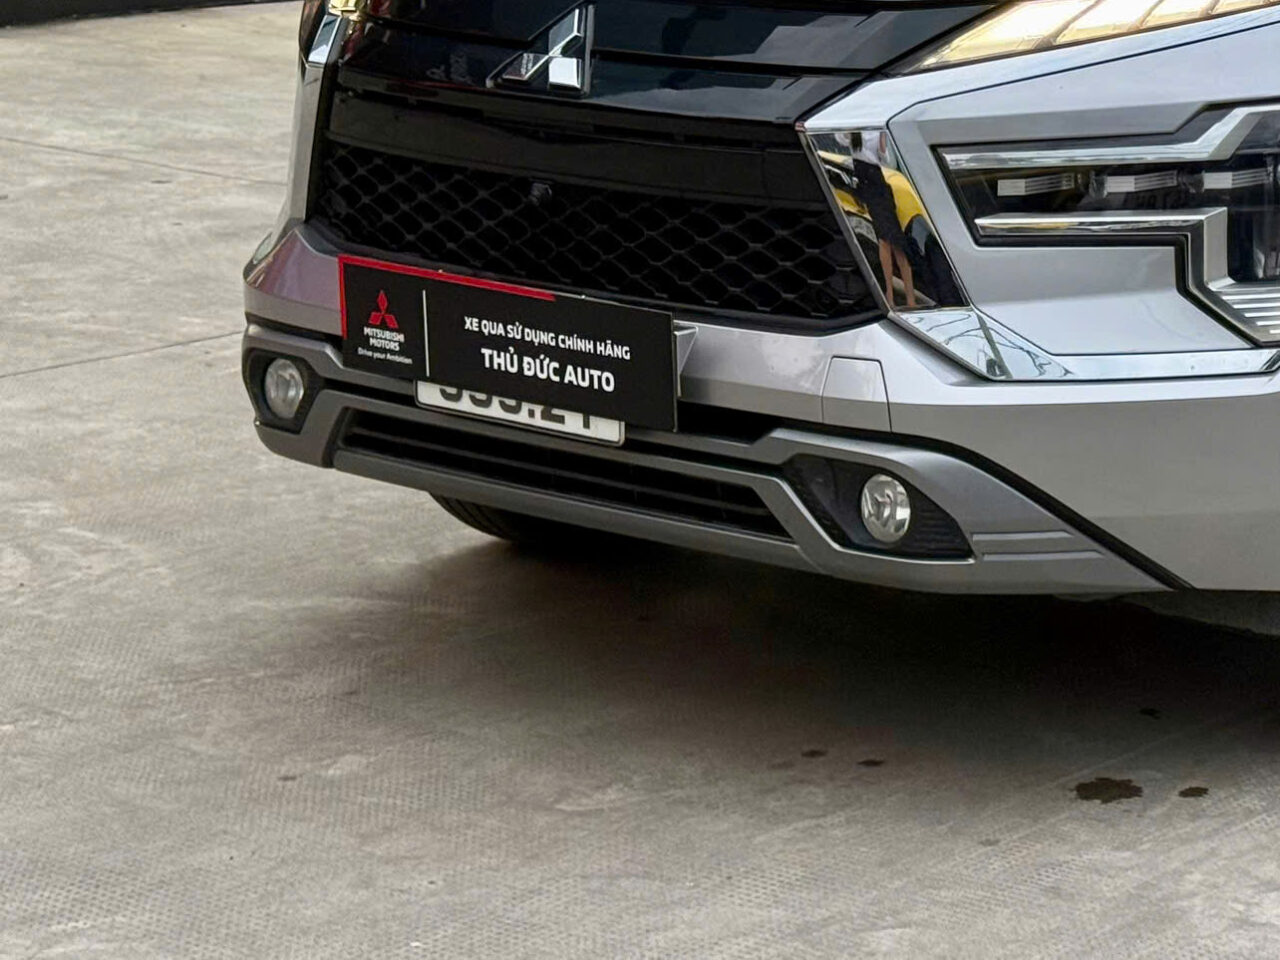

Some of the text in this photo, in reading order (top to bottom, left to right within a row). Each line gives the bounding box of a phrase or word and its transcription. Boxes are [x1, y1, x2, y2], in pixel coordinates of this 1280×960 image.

[363, 326, 405, 343] MITSUBISHI
[370, 338, 400, 351] MOTORS
[464, 316, 631, 360] XE QUA SỬ DỤNG CHÍNH HÃNG
[480, 346, 615, 392] THỦ ĐỨC AUTO
